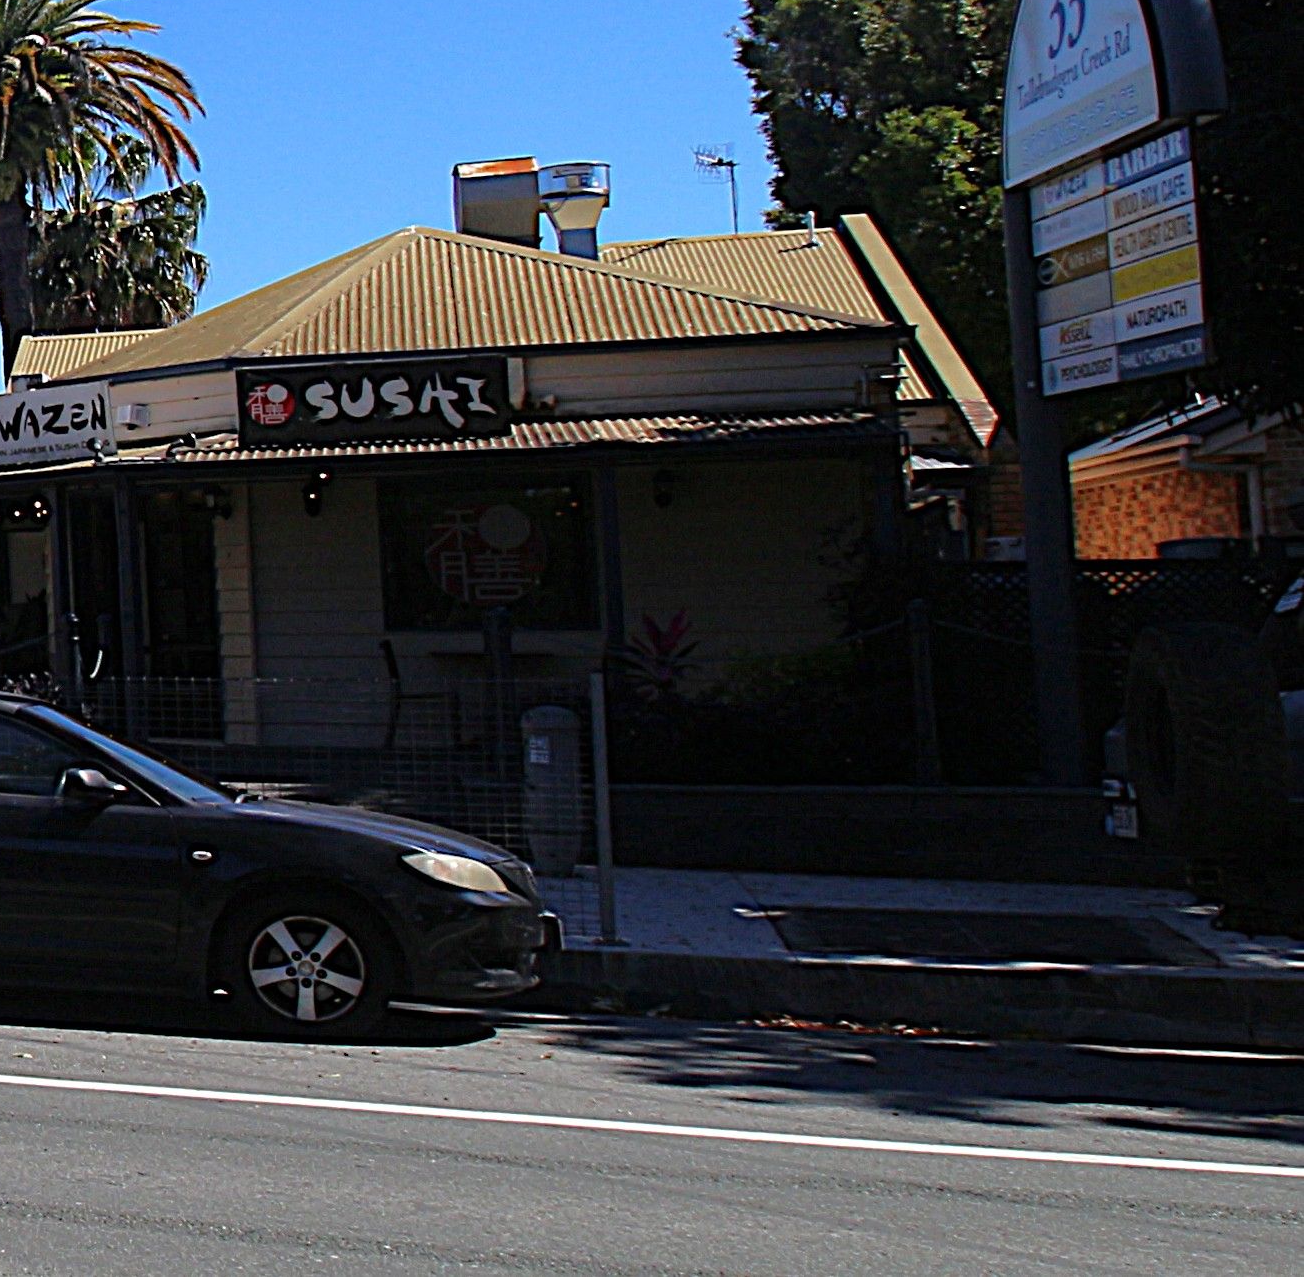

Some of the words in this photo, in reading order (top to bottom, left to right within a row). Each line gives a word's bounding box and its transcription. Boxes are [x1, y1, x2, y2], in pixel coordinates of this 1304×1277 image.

[1082, 35, 1112, 75] Creek
[1114, 23, 1131, 58] Rd
[1161, 173, 1186, 201] CAFE
[305, 373, 497, 428] SUSHI
